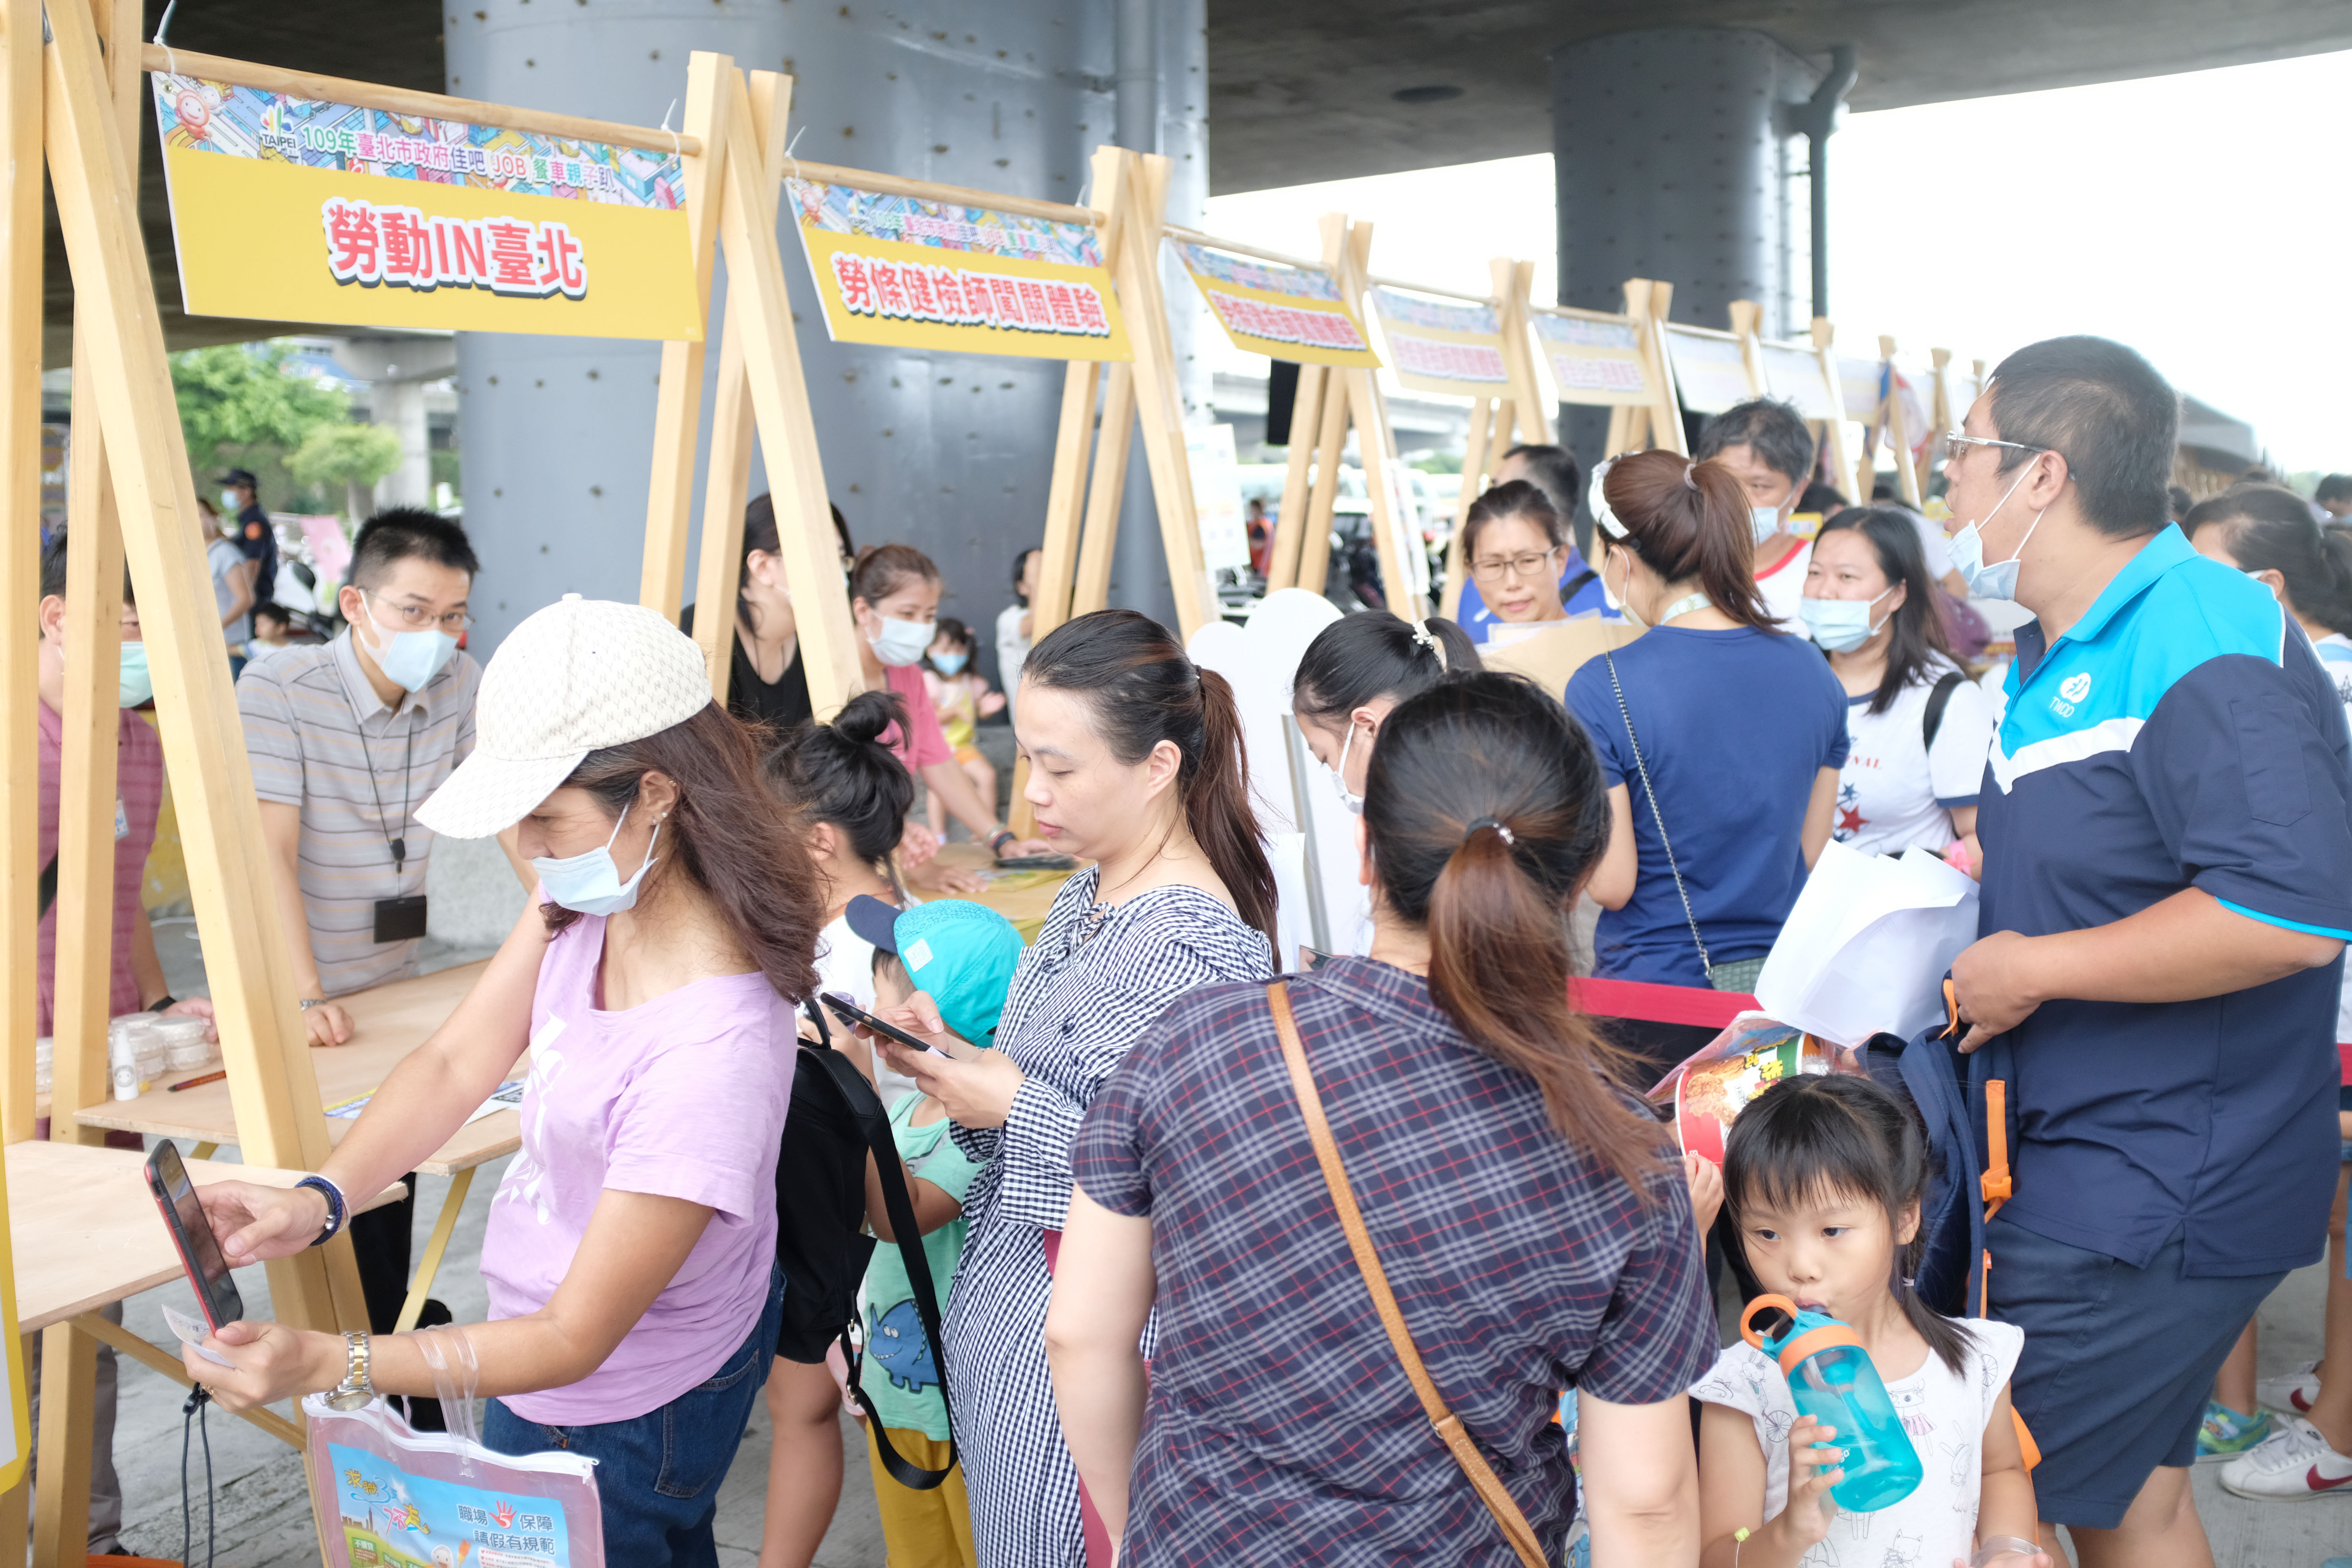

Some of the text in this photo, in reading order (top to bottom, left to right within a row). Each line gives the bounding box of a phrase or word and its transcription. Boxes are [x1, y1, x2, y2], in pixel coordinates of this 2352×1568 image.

[262, 134, 297, 149] TAIPEI
[327, 204, 582, 289] 勞動IN臺北
[457, 1505, 553, 1531] 職場 5 保障
[474, 1530, 555, 1555] 請假有規範
